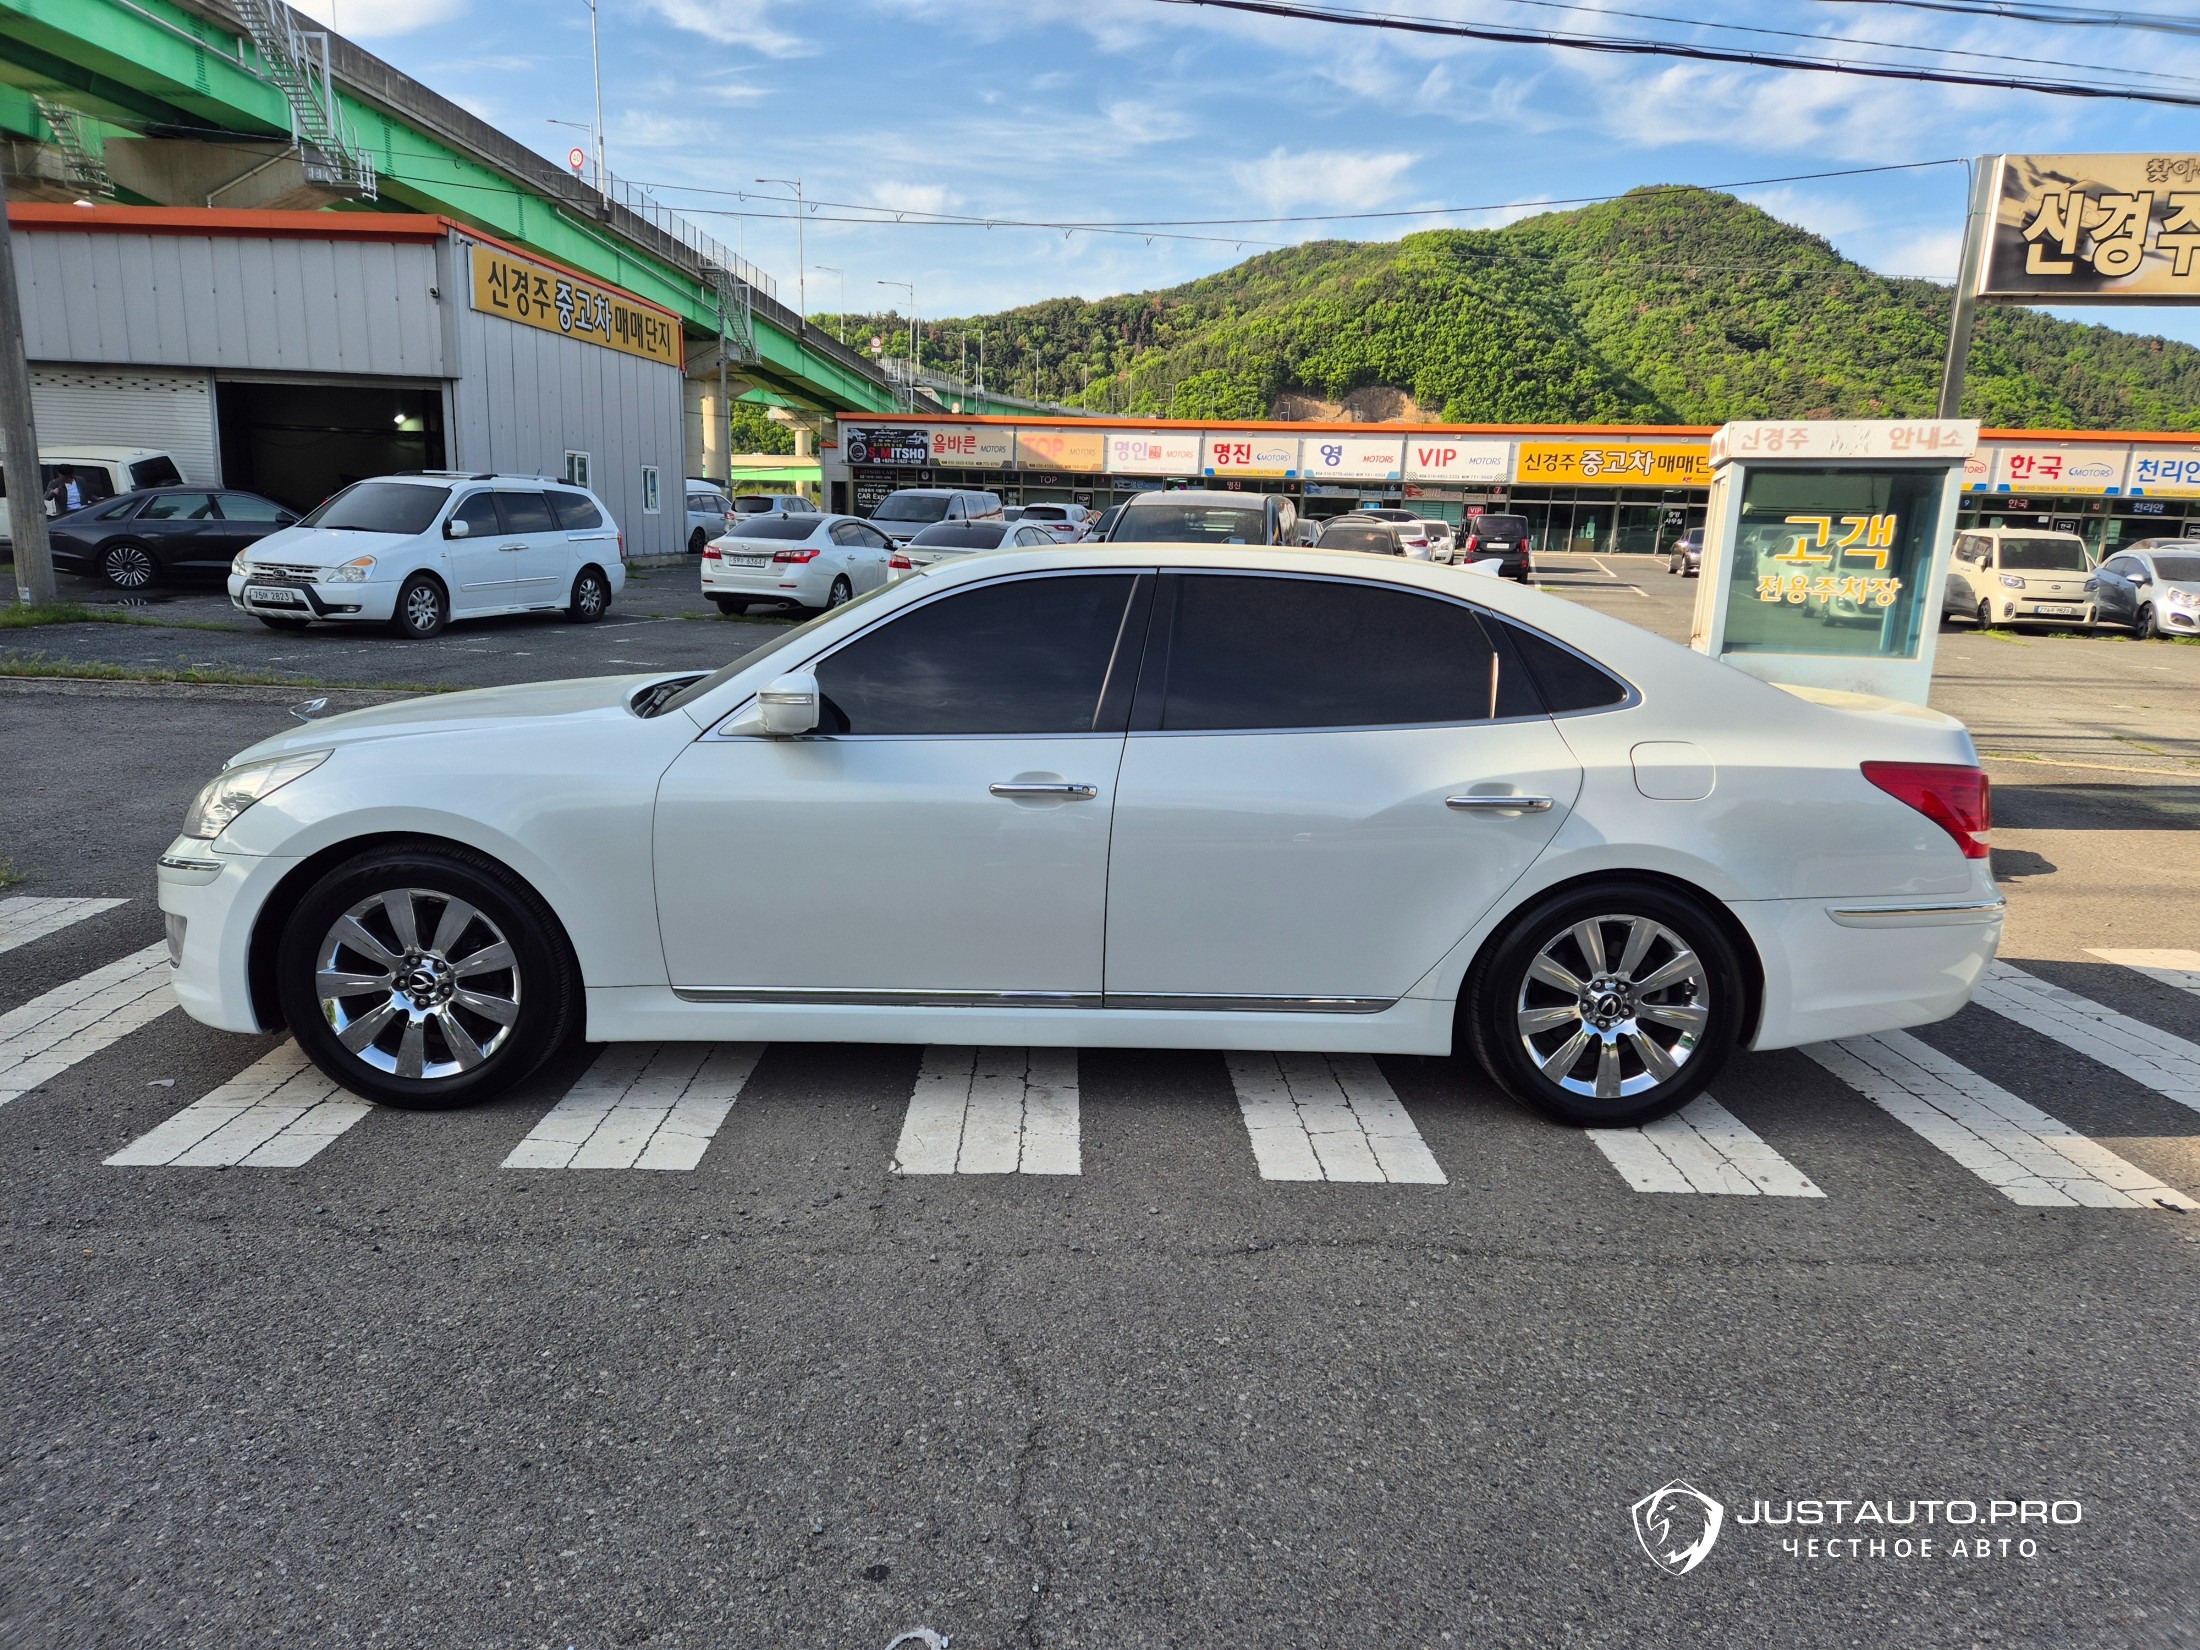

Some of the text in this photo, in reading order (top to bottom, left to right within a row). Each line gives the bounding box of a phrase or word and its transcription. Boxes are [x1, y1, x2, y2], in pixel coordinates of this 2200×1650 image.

[2146, 158, 2200, 183] 찾아
[2021, 189, 2200, 279] 신경주
[487, 260, 671, 357] 신경주 중고차 매매단지
[932, 433, 1007, 455] 올바른 MOTORS
[1023, 437, 1097, 458] TOP MOTORS
[1740, 427, 1810, 451] 신경주
[1889, 426, 1963, 450] 안내소
[1114, 441, 1148, 462] 명인
[1165, 450, 1194, 458] MOTORS
[1213, 443, 1289, 465] 명진 MOTORS
[1320, 444, 1394, 467] 영 MOTORS
[1418, 448, 1501, 467] VIP MOTORS
[1525, 453, 1576, 472] 신경주
[1578, 449, 1656, 477] 중고차
[2009, 454, 2110, 480] 한국 MOTORS
[1040, 475, 1058, 484] TOP
[1226, 481, 1241, 490] 명진
[1469, 506, 1482, 515] VIP
[1964, 499, 1970, 507] 9
[2008, 499, 2030, 510] 한국
[2132, 502, 2165, 513] 천리안
[1774, 513, 1897, 571] 고객
[270, 592, 290, 601] 2823
[1756, 575, 1903, 607] 전용주차장
